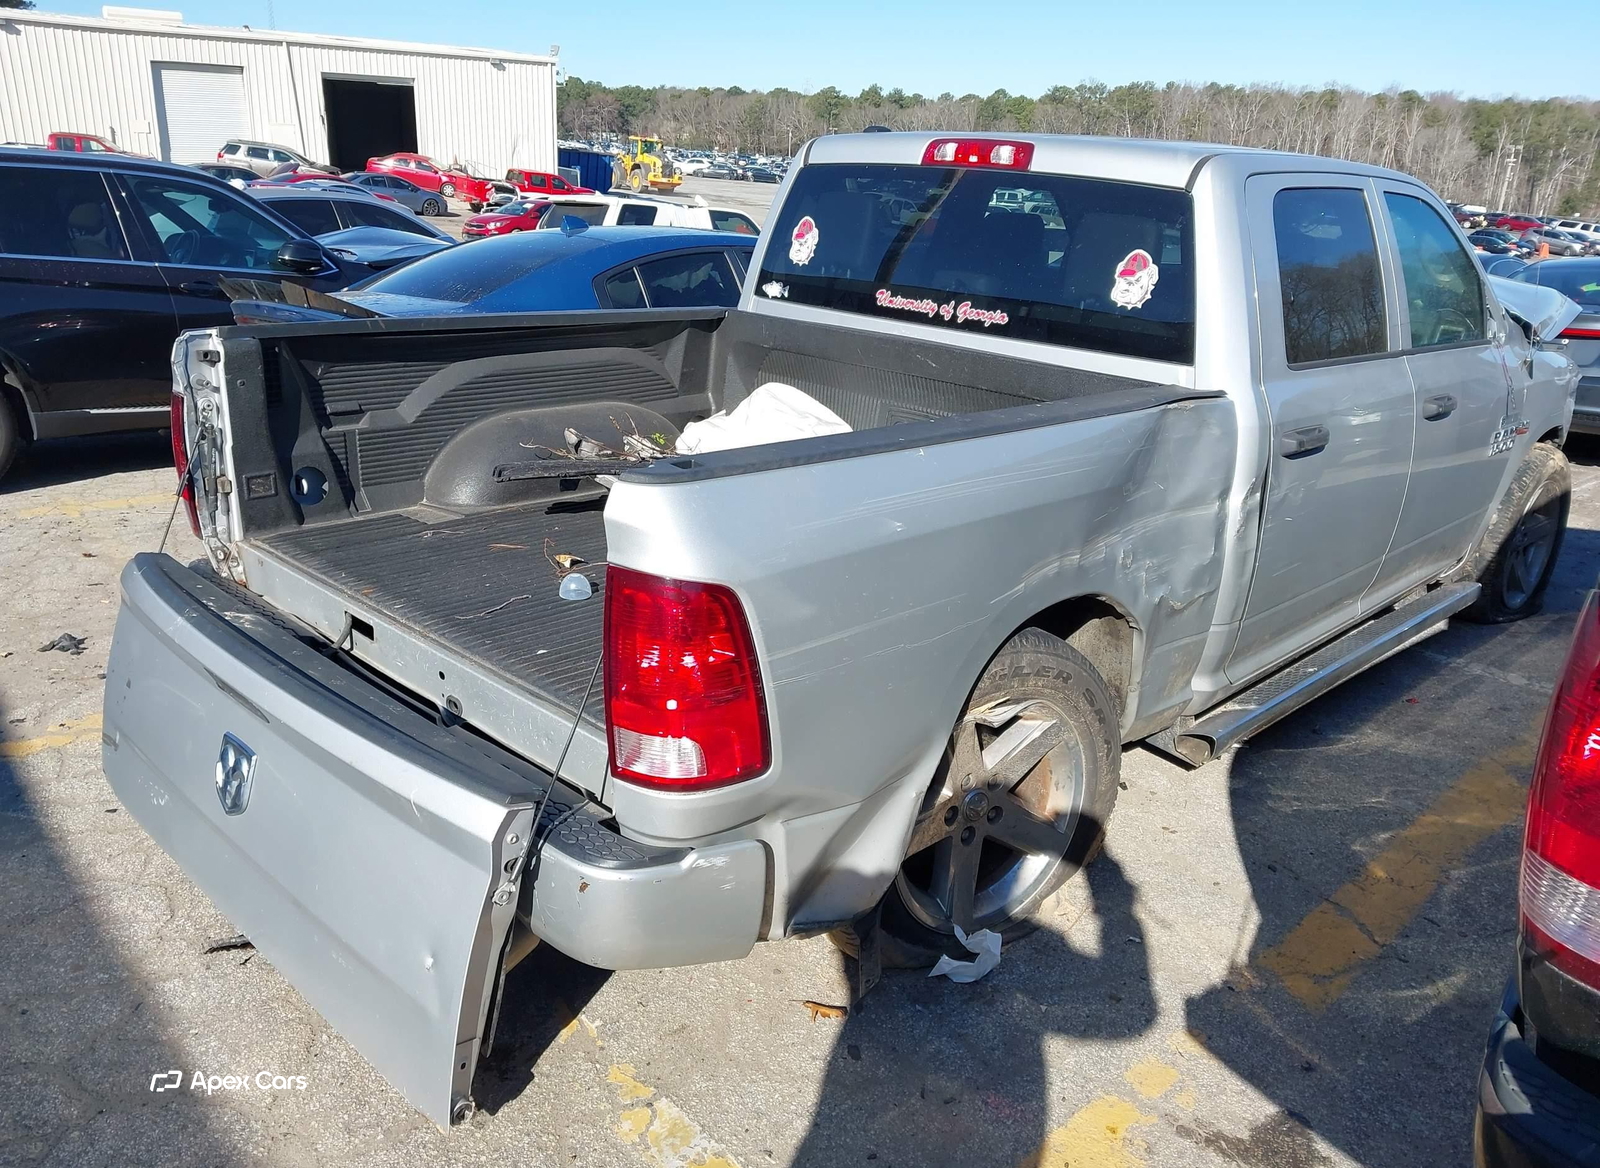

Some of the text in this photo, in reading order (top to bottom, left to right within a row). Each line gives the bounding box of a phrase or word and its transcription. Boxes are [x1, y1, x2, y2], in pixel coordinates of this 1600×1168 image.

[876, 289, 1009, 327] University of Georgia
[1488, 439, 1515, 458] 1500
[987, 665, 1073, 685] GLER
